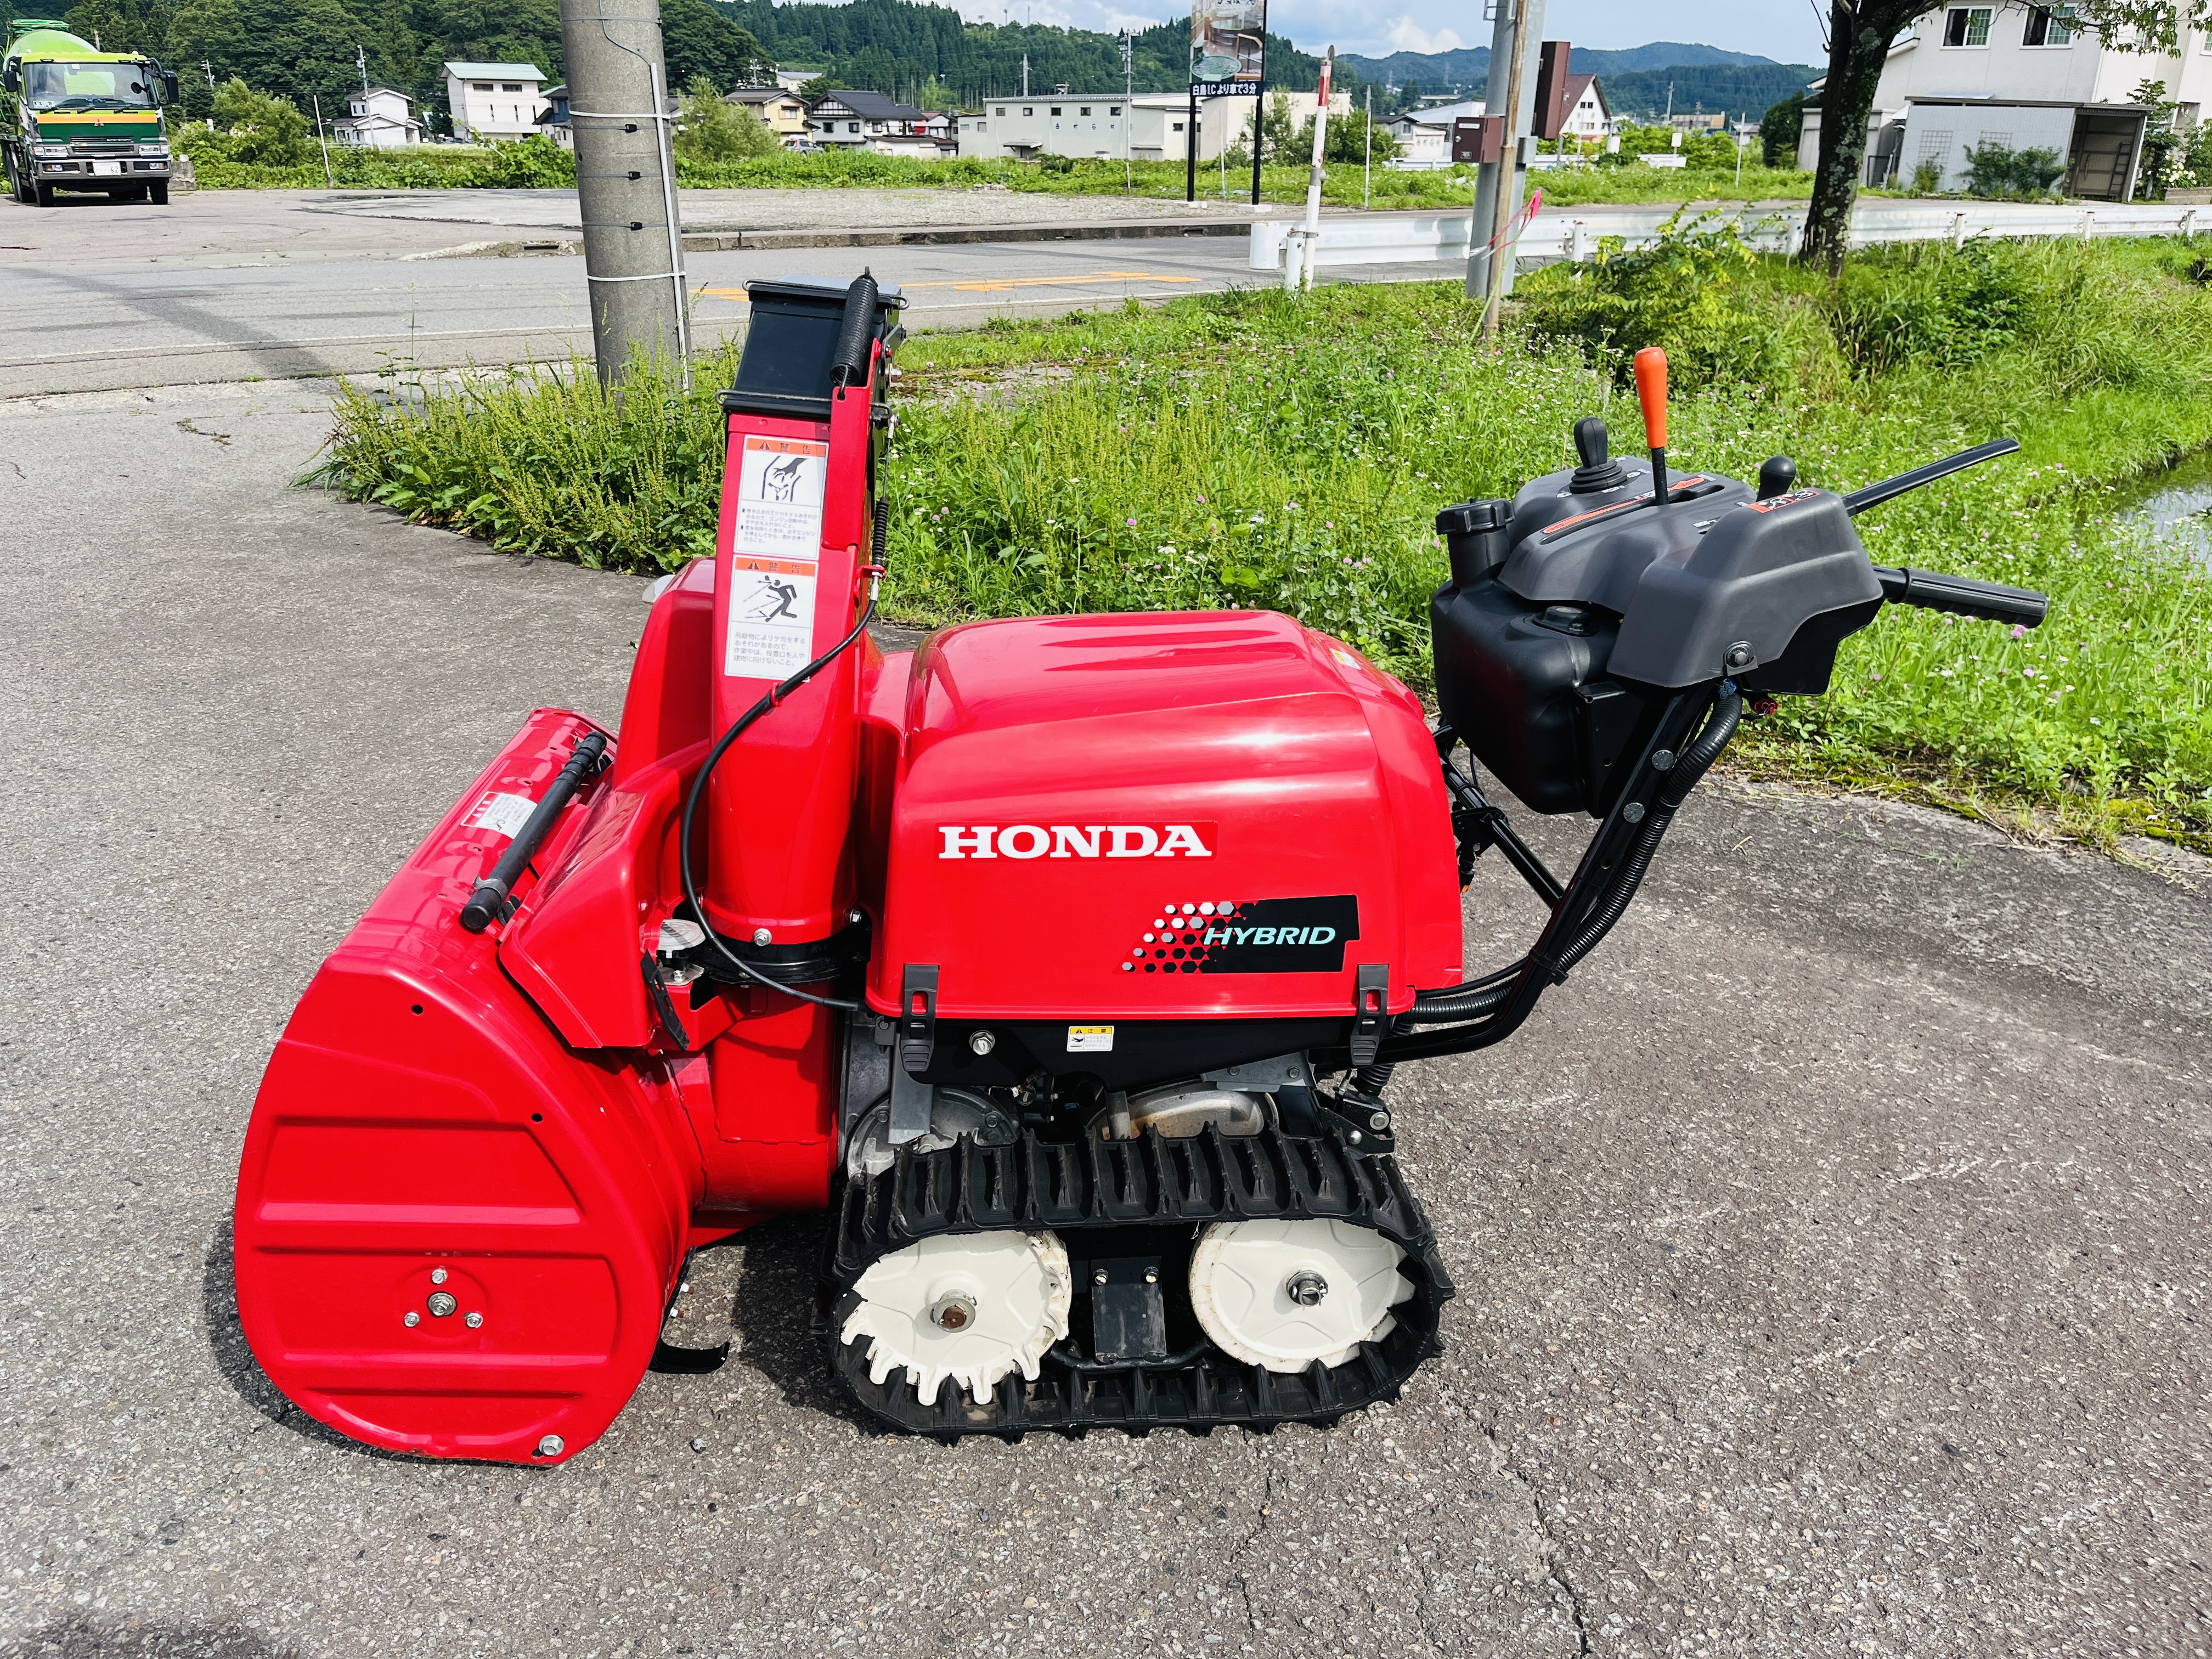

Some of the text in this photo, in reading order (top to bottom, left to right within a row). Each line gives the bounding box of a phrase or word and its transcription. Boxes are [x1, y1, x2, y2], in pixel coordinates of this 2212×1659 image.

[780, 443, 811, 454] 警告
[769, 562, 800, 573] 警告
[938, 825, 1212, 859] HONDA
[1204, 927, 1336, 945] HYBRID
